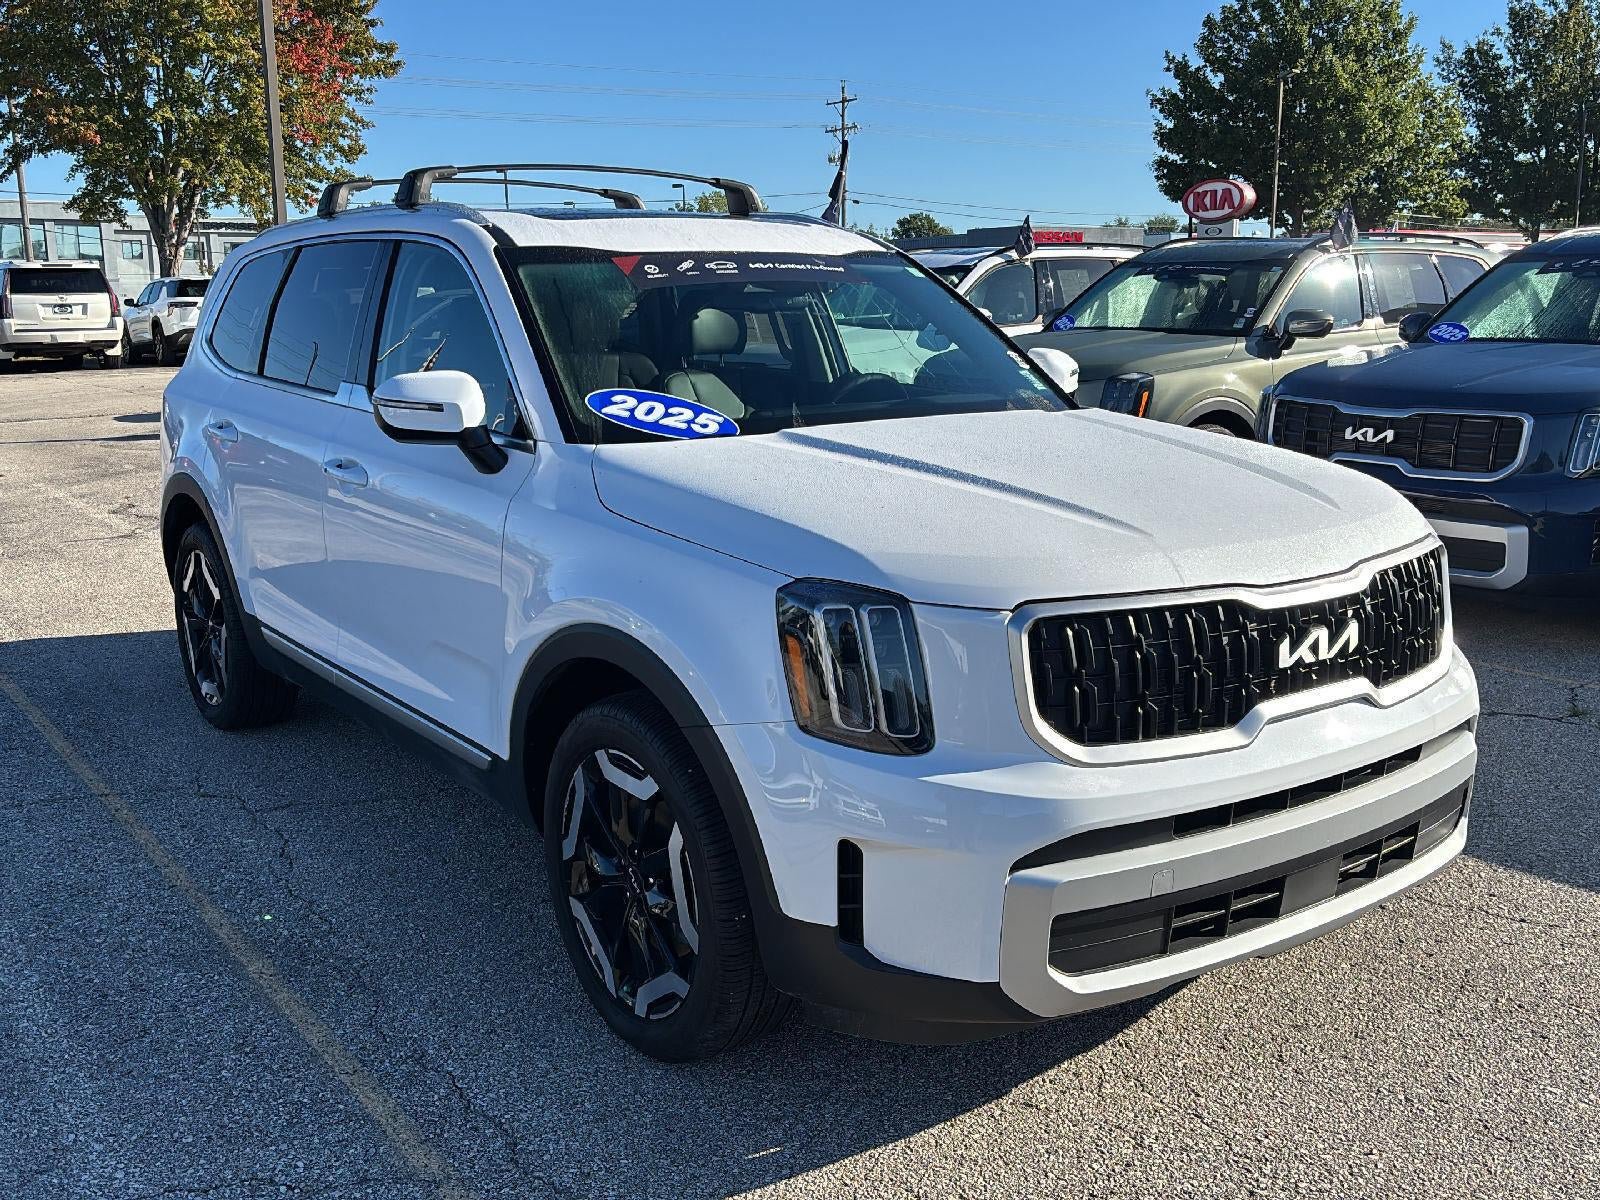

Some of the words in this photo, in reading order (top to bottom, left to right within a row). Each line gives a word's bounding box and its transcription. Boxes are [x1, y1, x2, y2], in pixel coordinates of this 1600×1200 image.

[1193, 188, 1235, 212] KIA
[1430, 324, 1468, 341] 2025
[601, 394, 725, 435] 2025
[1345, 426, 1394, 443] KIA
[1279, 620, 1359, 668] KIA
